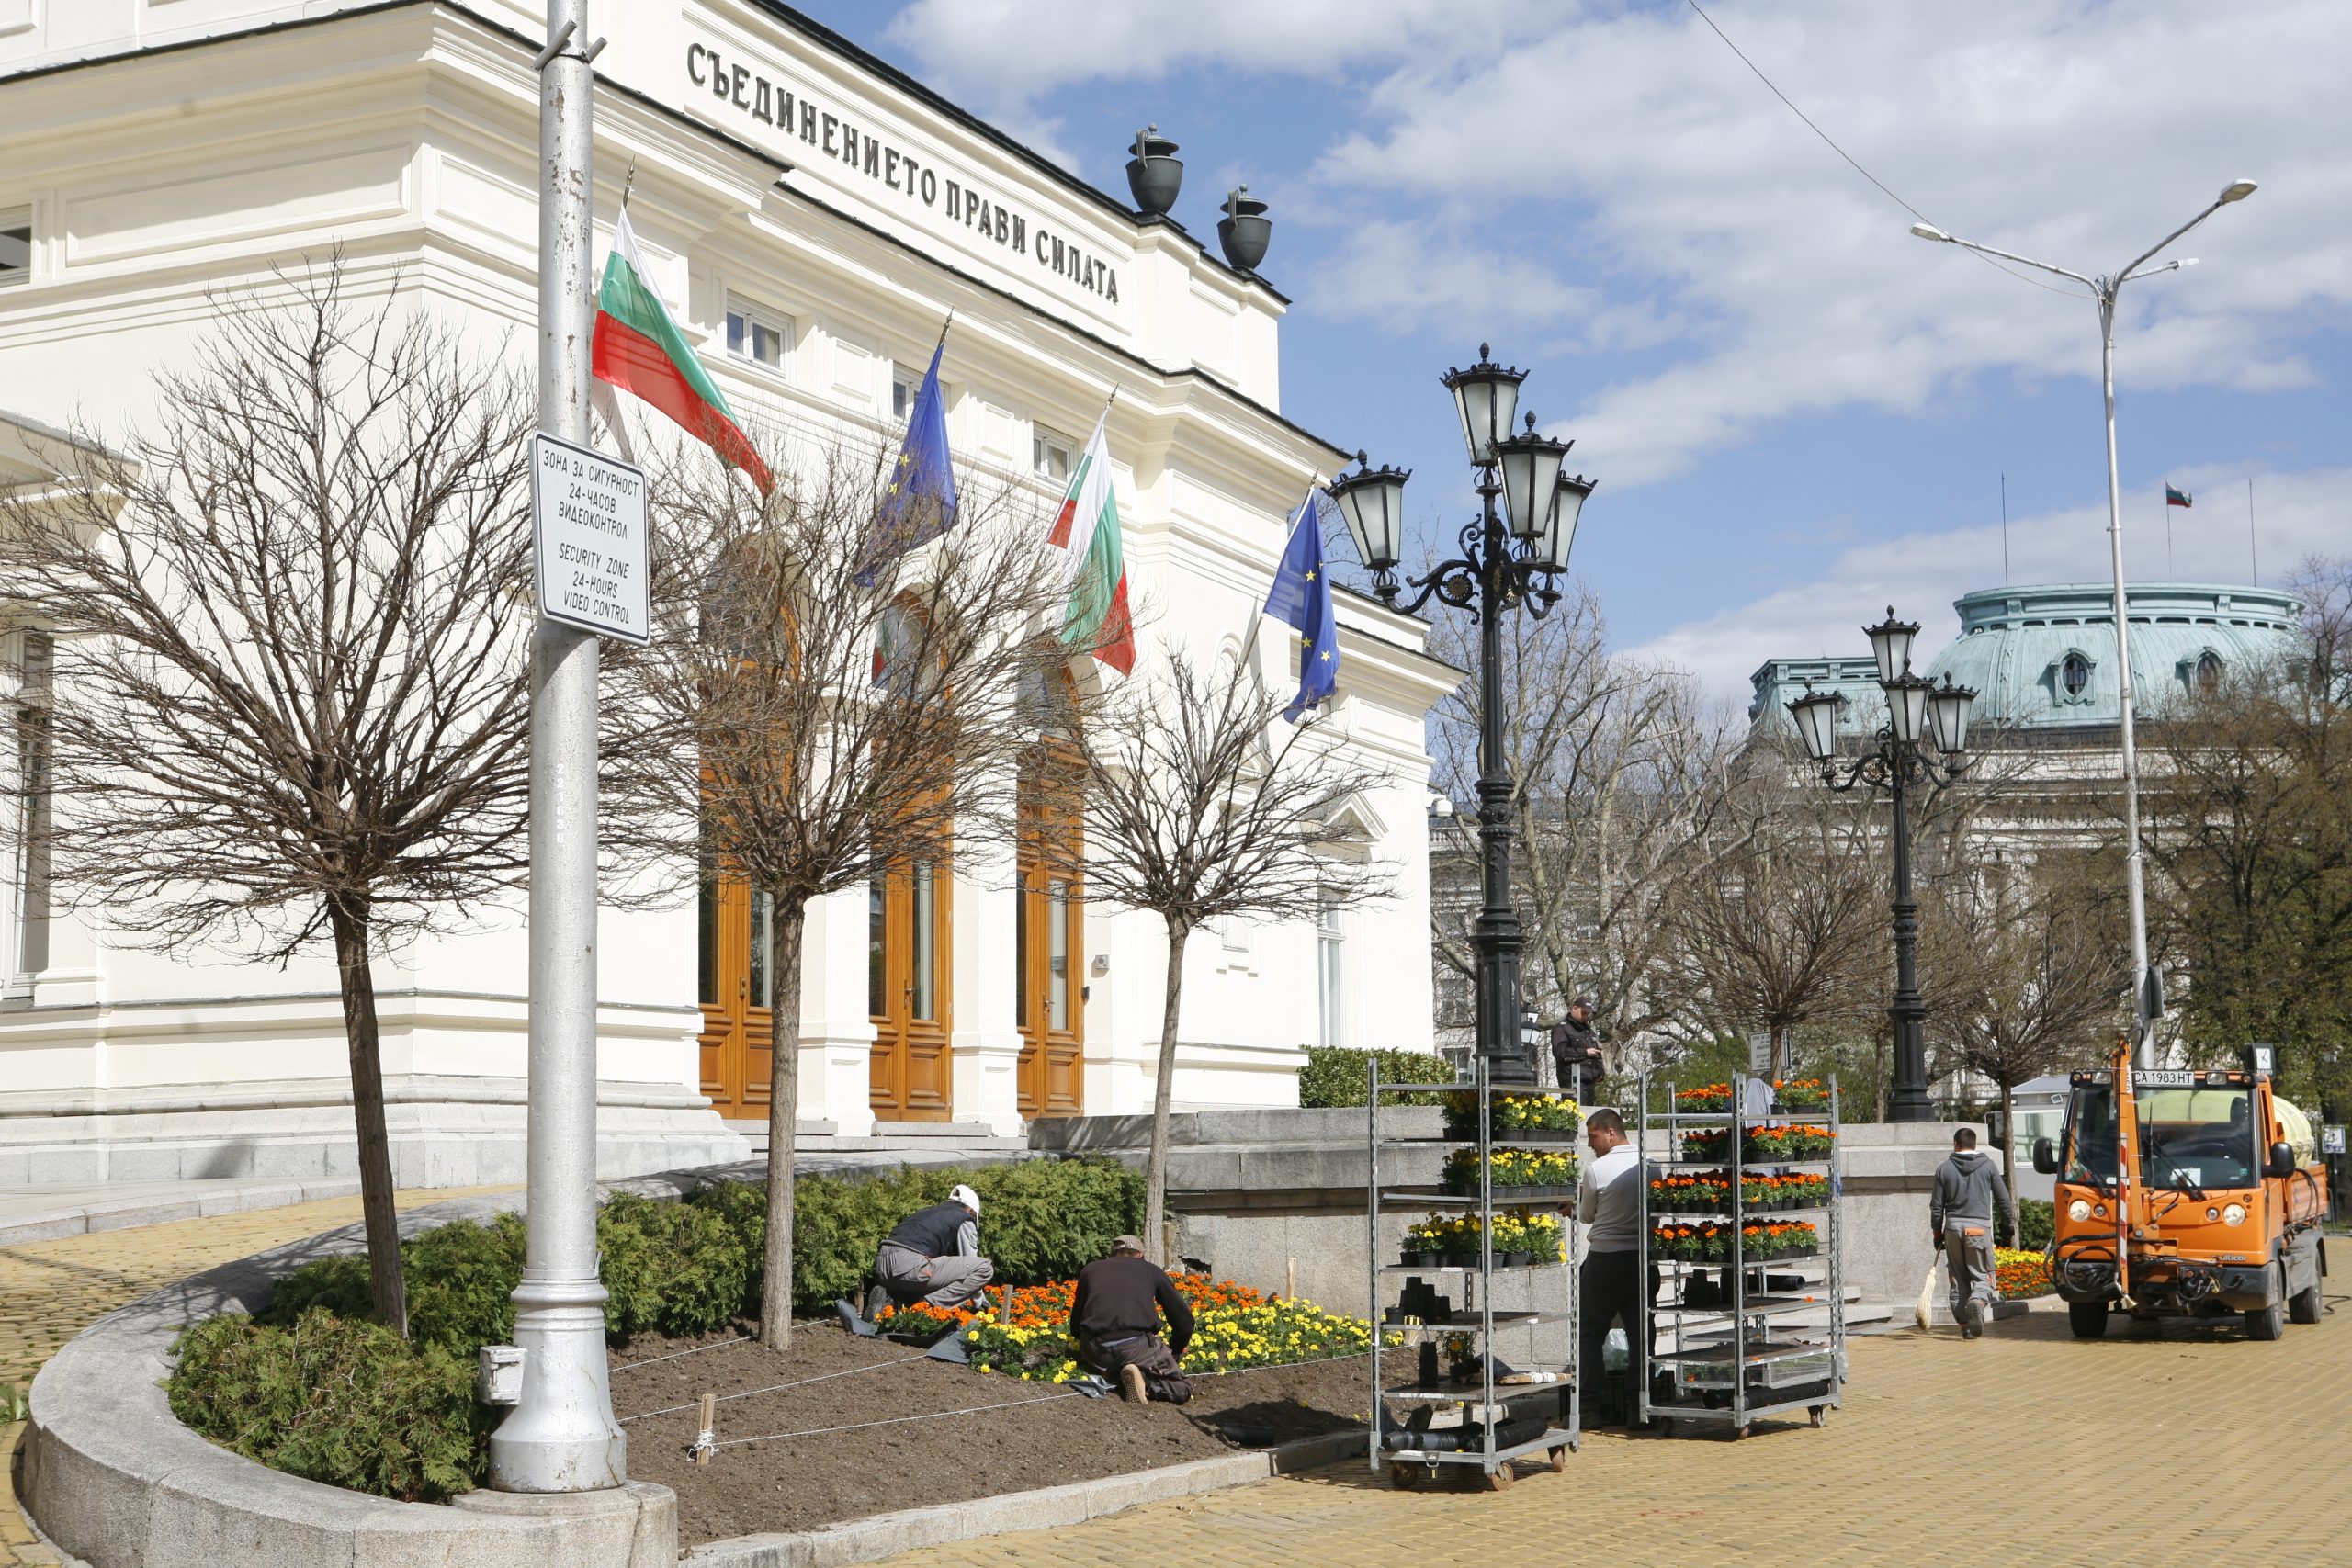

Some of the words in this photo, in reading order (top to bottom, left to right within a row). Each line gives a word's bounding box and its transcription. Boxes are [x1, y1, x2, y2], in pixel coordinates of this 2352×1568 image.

[687, 42, 936, 206] СЪЕДИНЕНИЕТО
[945, 178, 1026, 254] ПРАВИ
[1035, 229, 1119, 303] СИЛАТА
[543, 449, 568, 473] ЗОНА
[572, 461, 584, 480] ЗА
[588, 466, 639, 498] СИГУРНОСТ
[569, 483, 616, 513] 24-ЧАСОВ
[558, 502, 628, 539] ВИДЕОКОНТРОЛ
[559, 543, 602, 570] SECURITY
[606, 558, 630, 579] ZONE
[572, 571, 618, 598] 24-HOURS
[564, 590, 589, 612] VIDEO
[593, 599, 629, 624] CONTROL
[2152, 1072, 2176, 1083] 1983
